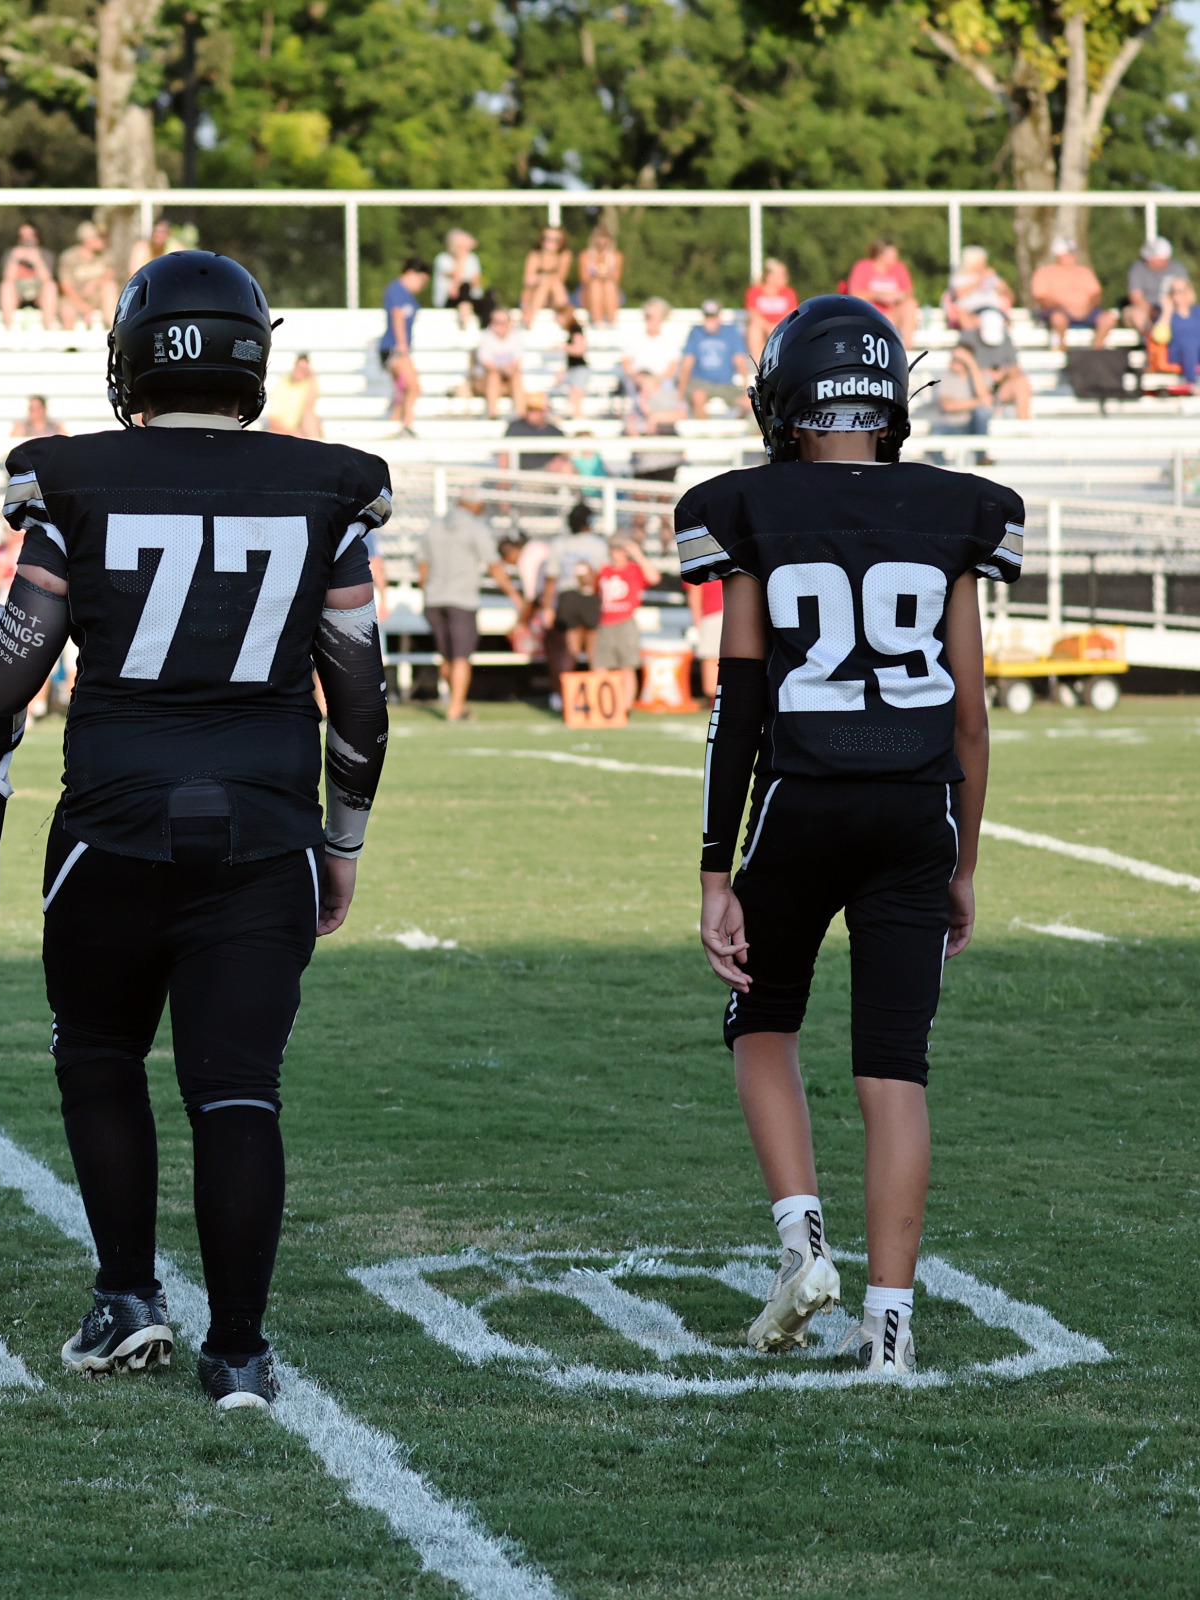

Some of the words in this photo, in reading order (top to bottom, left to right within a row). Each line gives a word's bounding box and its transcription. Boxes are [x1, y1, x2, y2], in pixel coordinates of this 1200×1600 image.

[168, 324, 202, 361] 30
[862, 333, 890, 369] 30
[816, 376, 894, 401] Riddell
[798, 411, 837, 429] PRO
[851, 410, 882, 429] NIKE
[8, 602, 26, 620] GOD
[105, 513, 310, 683] 77
[1, 611, 46, 648] HINGS
[766, 561, 956, 713] 29
[574, 680, 617, 719] 40
[376, 732, 388, 744] GO
